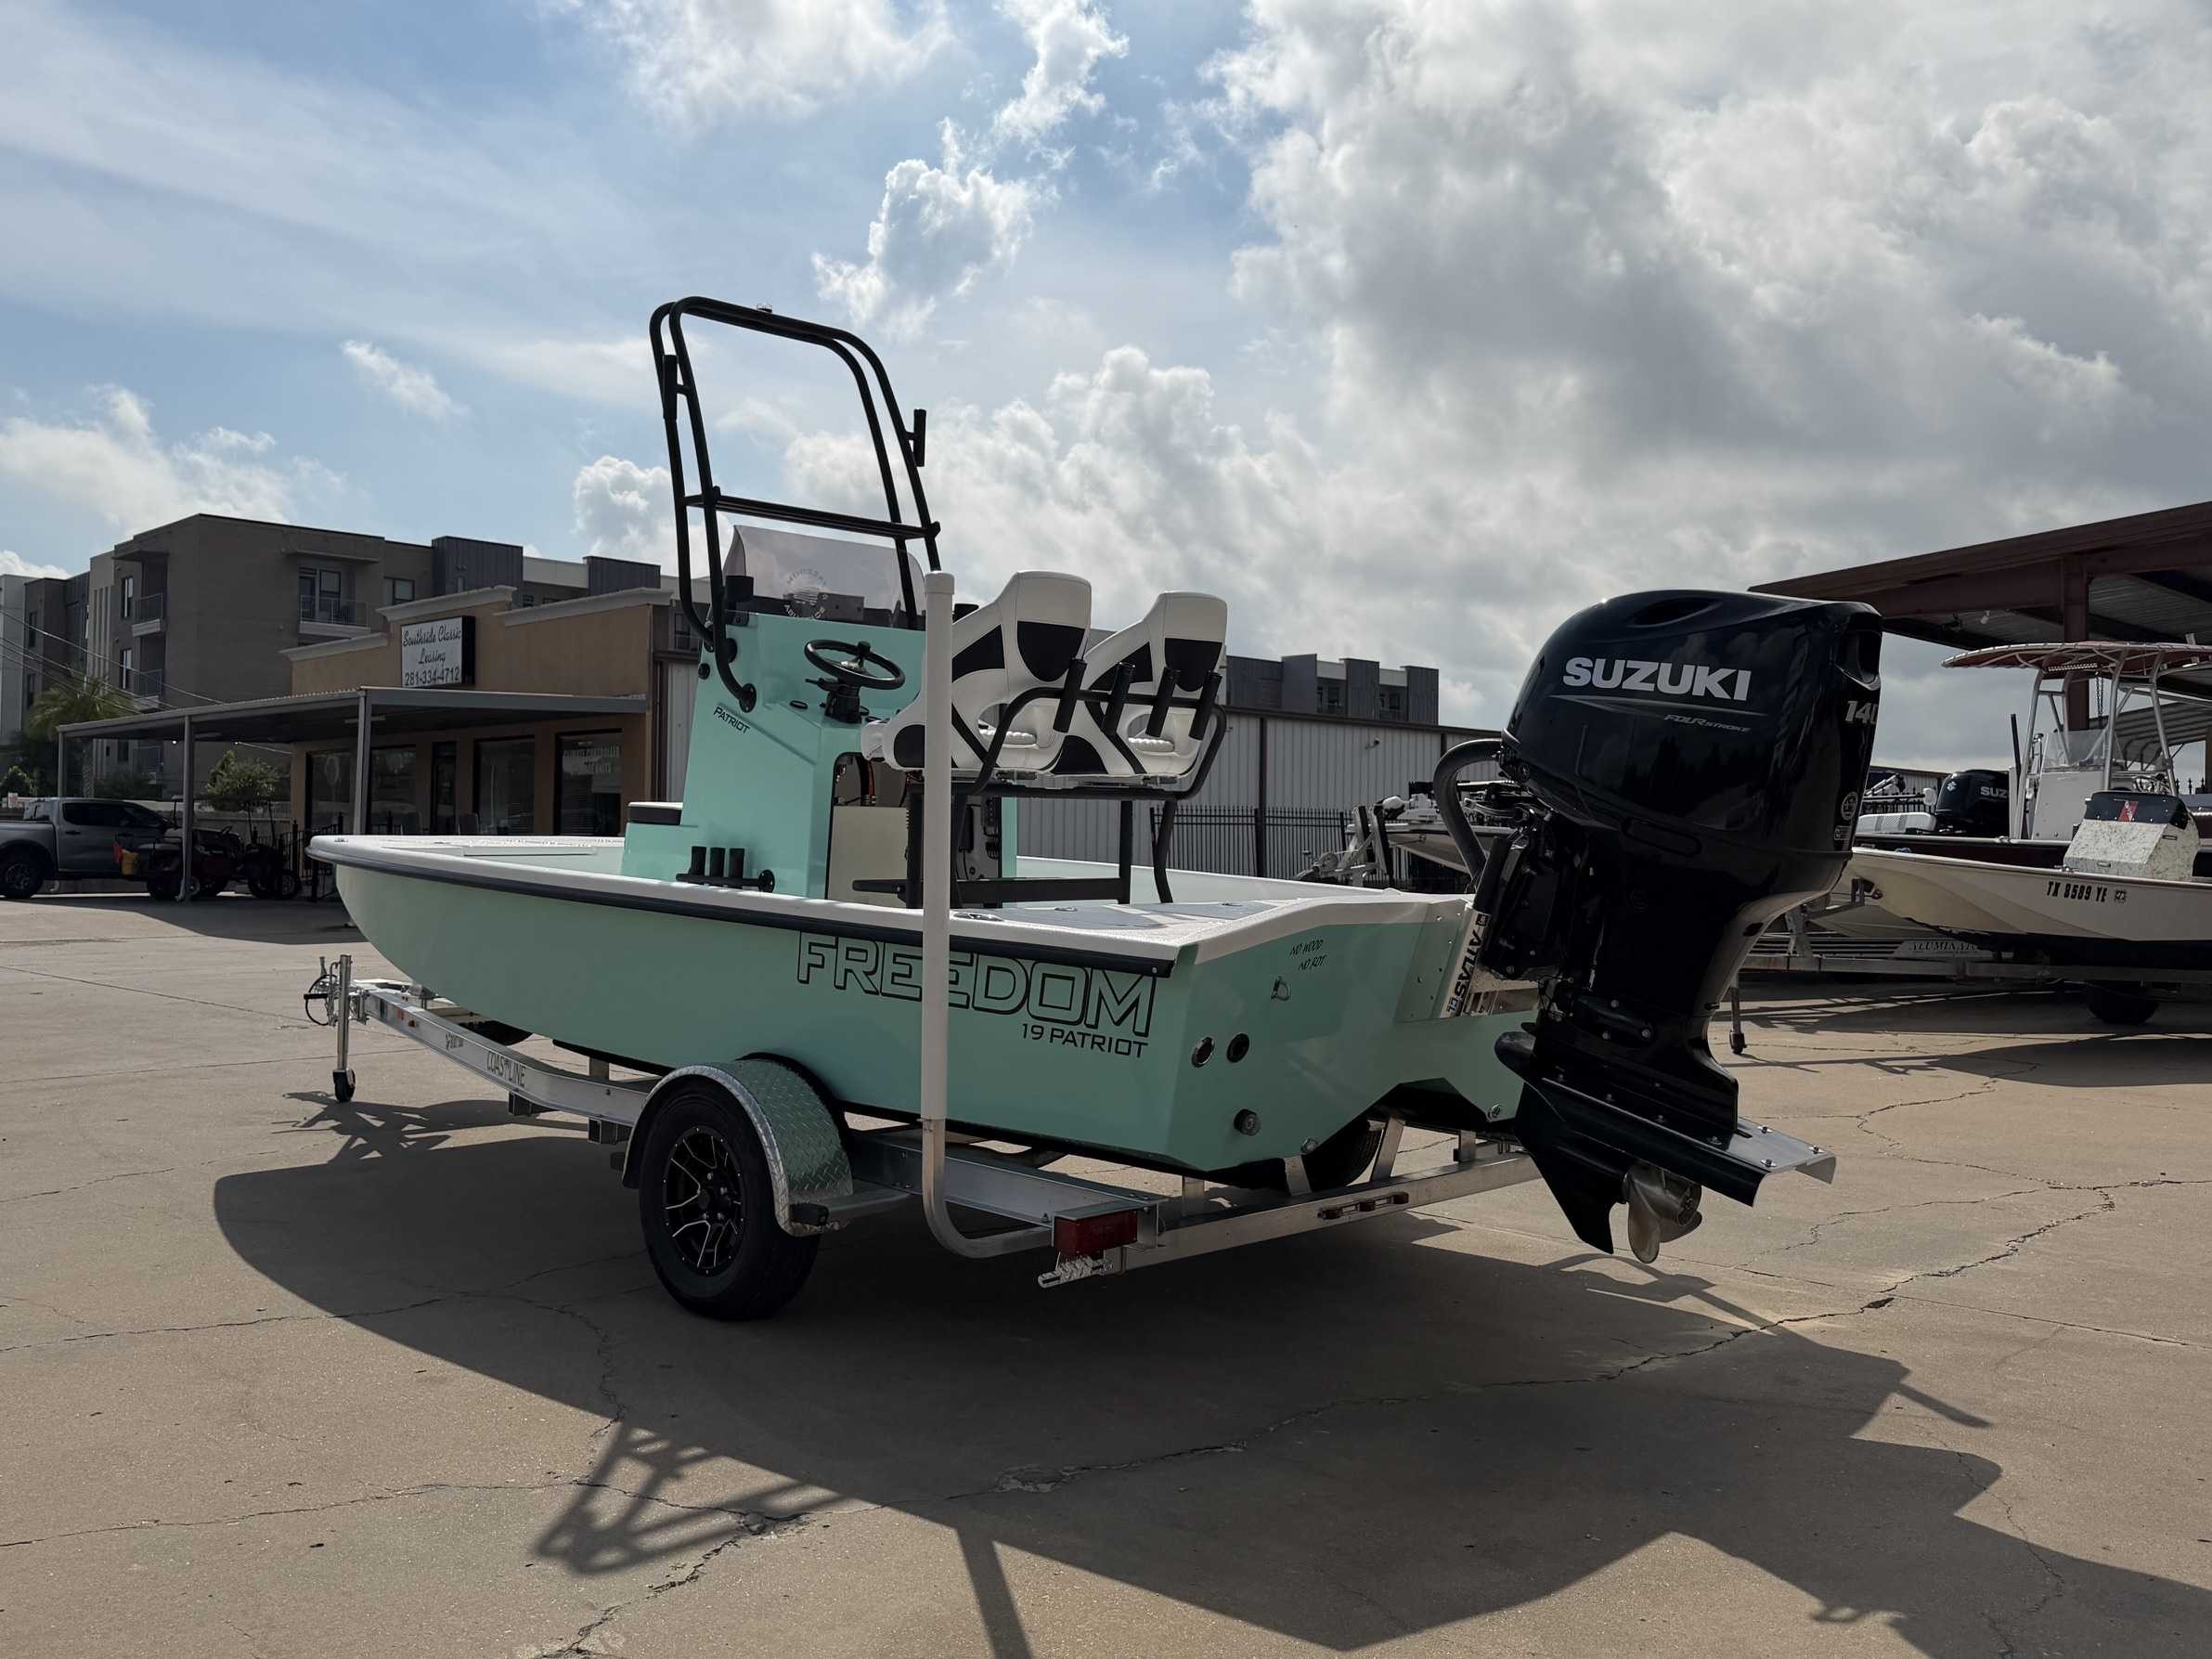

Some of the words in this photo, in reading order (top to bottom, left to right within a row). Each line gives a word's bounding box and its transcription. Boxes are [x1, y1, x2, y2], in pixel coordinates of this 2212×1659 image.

[403, 626, 436, 646] Southside
[438, 625, 461, 642] Classic
[418, 647, 446, 667] Leasing
[405, 667, 459, 686] 281-334-4712
[1562, 656, 1753, 701] SUZUKI
[1980, 785, 2008, 798] SUZ
[2047, 881, 2062, 897] TX
[1290, 942, 1303, 955] NO
[1298, 959, 1311, 970] NO
[1455, 929, 1482, 999] ATLAS
[796, 930, 1158, 1039] FREEDOM
[1022, 1023, 1044, 1040] 19
[1049, 1028, 1149, 1058] PATRIOT
